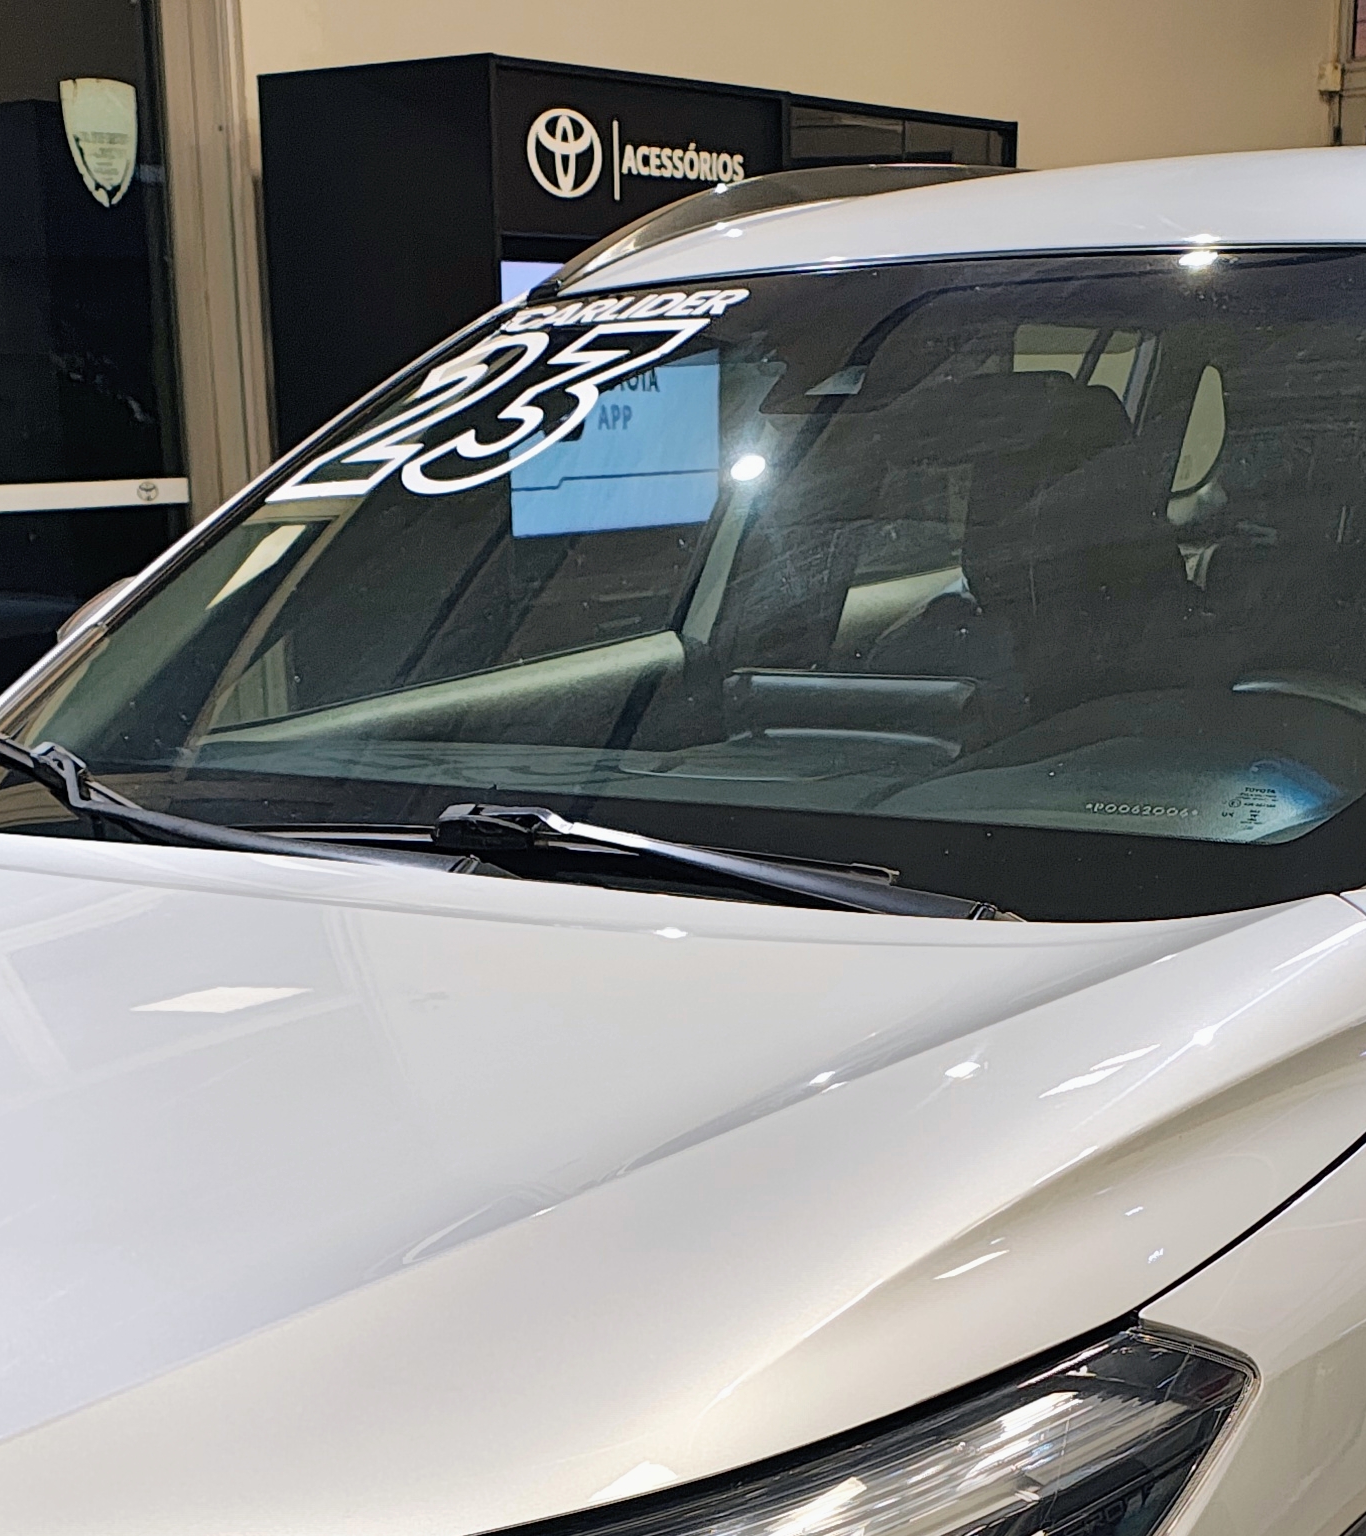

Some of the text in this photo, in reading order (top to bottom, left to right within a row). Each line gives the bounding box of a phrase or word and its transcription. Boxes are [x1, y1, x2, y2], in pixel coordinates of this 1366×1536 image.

[621, 142, 746, 182] ACESSÓRIOS
[505, 288, 751, 333] CARLIDER
[597, 403, 633, 431] APP
